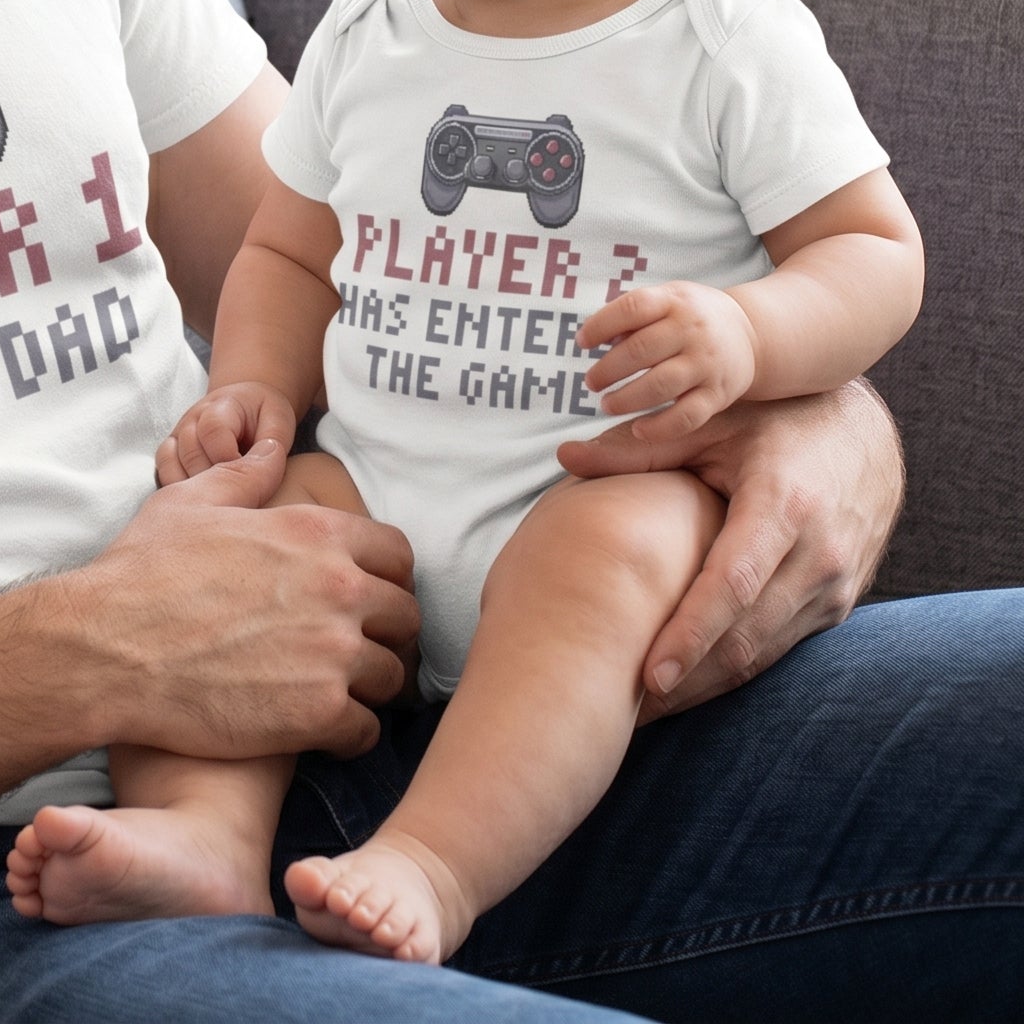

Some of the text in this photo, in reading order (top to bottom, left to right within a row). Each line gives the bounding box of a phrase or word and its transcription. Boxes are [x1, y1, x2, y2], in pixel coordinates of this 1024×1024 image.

[80, 151, 143, 264] 1
[352, 214, 648, 303] PLAYER 2
[338, 282, 614, 360] HAS ENTER
[366, 344, 597, 416] THE GAME
